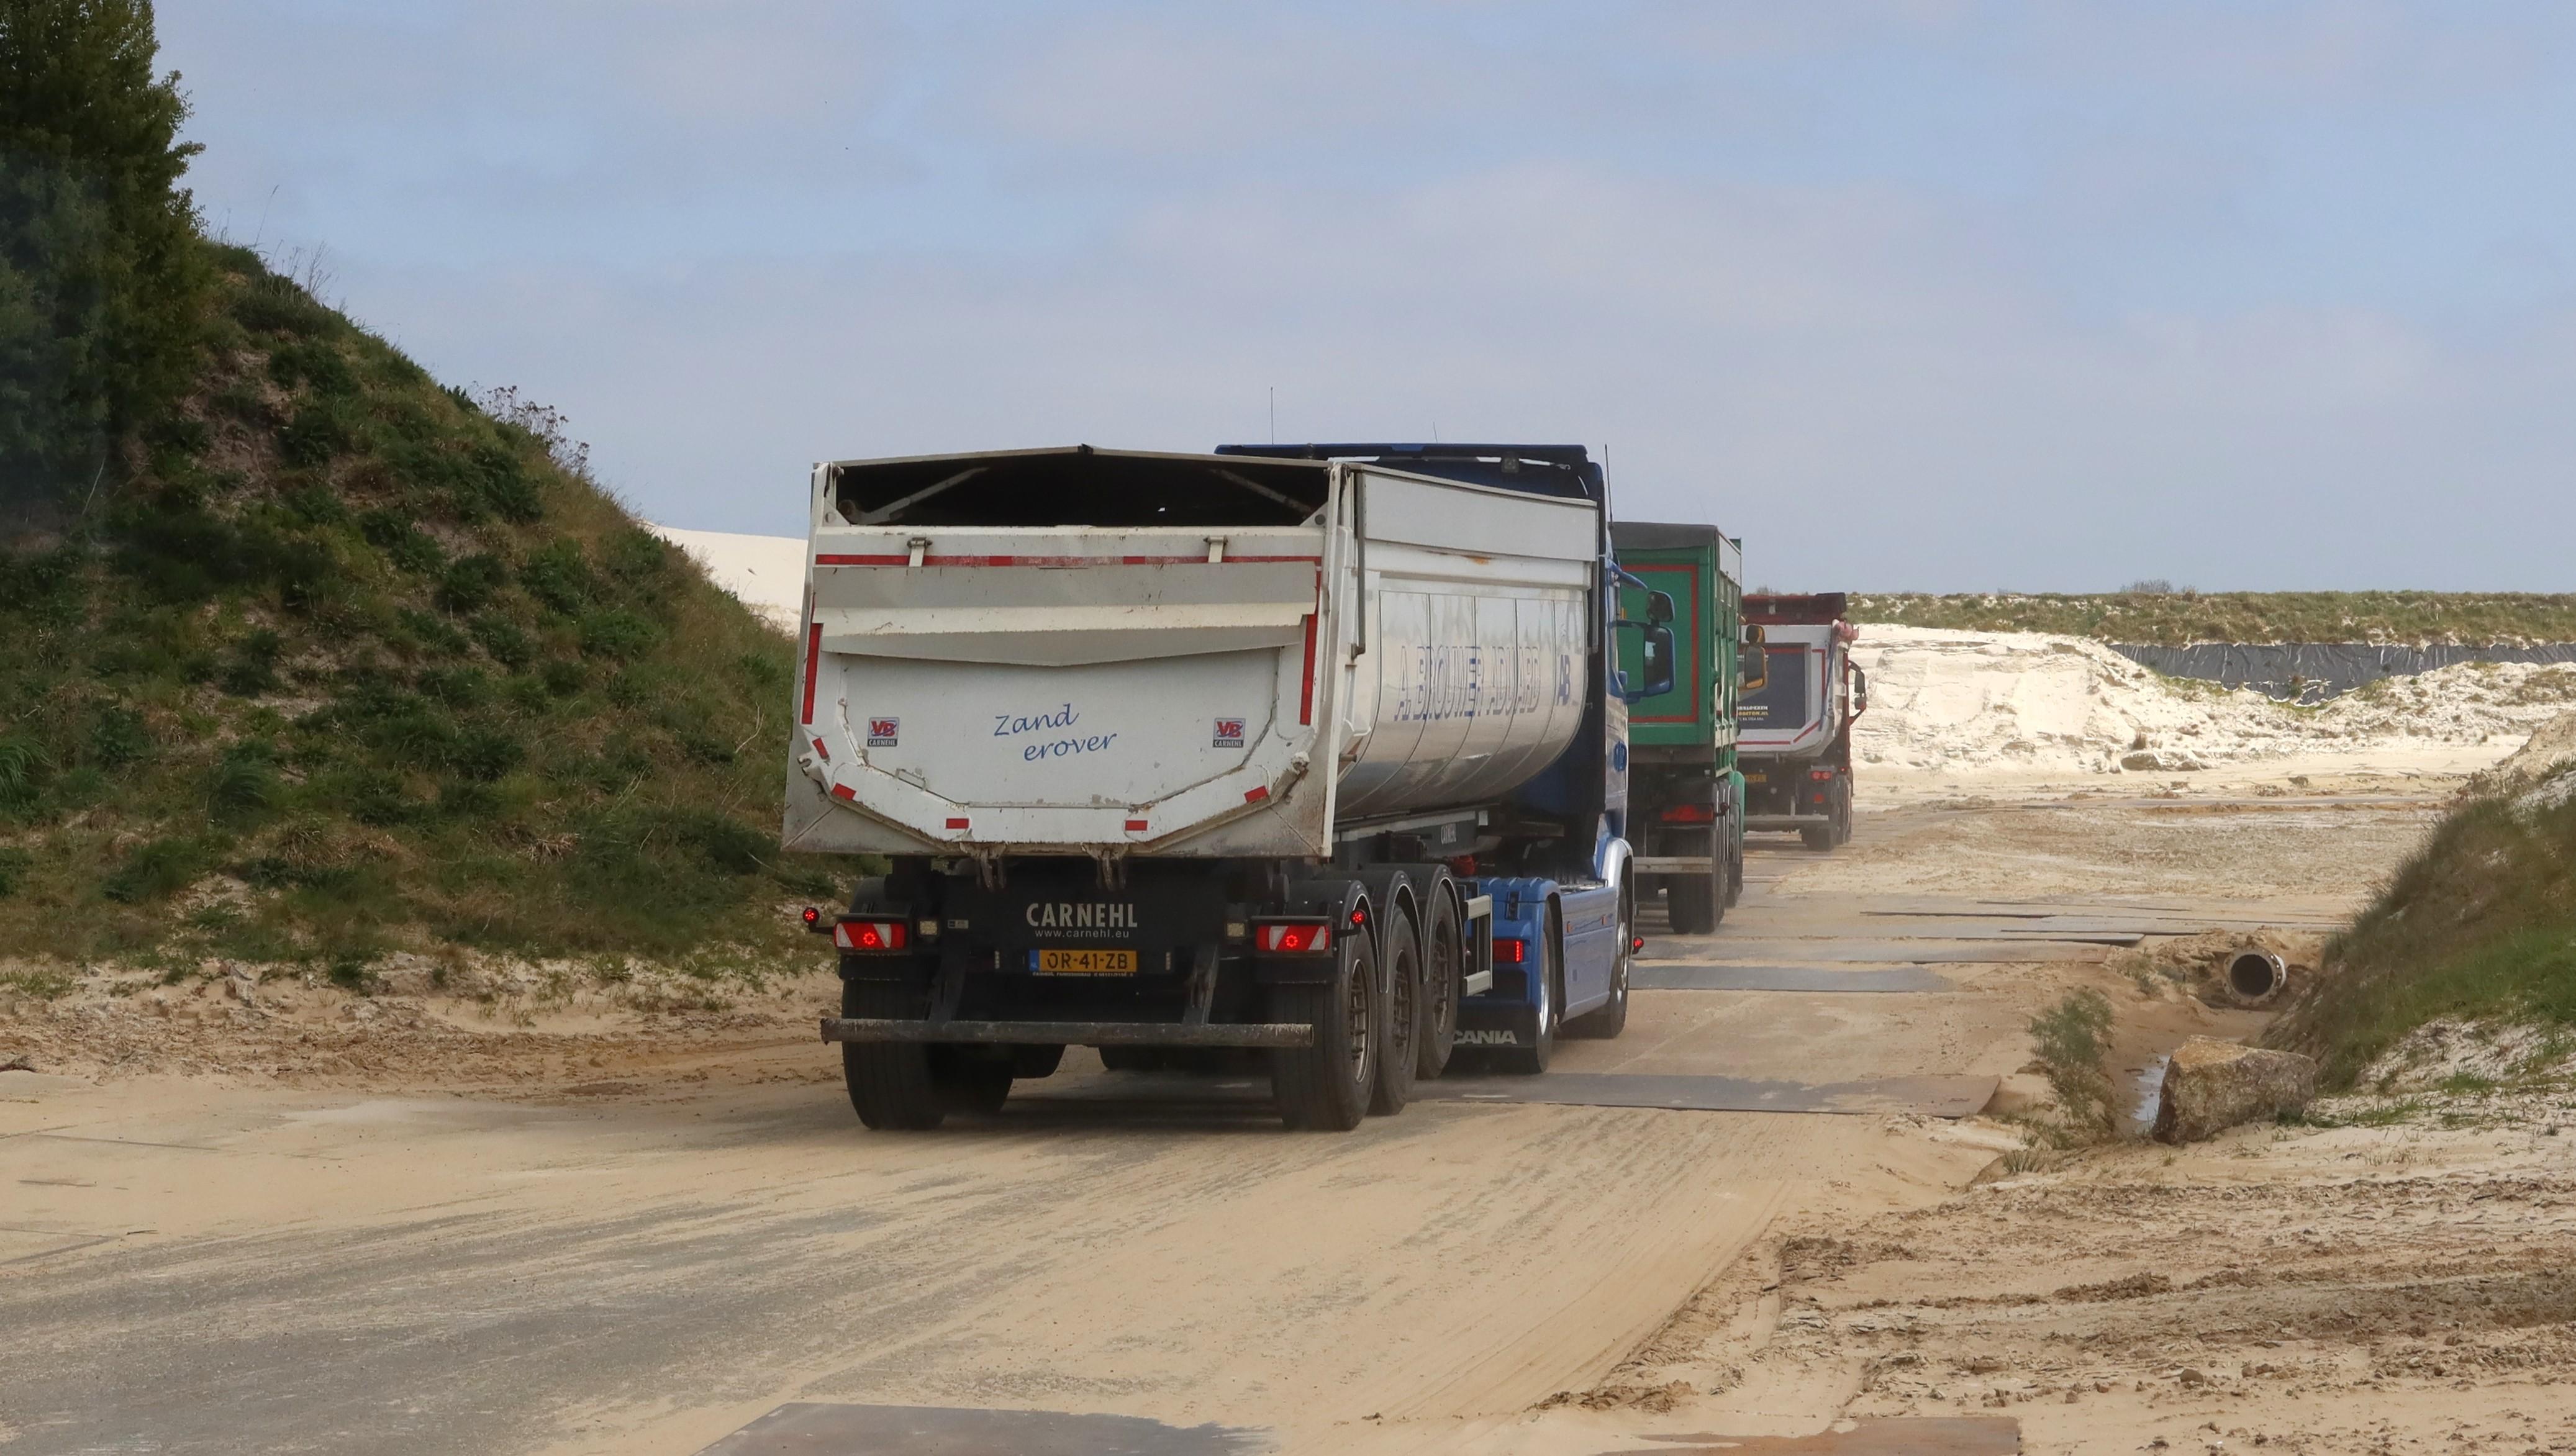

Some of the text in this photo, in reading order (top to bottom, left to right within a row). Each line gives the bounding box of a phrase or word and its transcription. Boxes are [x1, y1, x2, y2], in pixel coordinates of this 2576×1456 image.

[1413, 644, 1485, 721] BROUWER
[994, 702, 1080, 737] Zand
[1023, 733, 1118, 761] erover
[1026, 903, 1138, 928] CARNEHL
[1035, 929, 1130, 939] www.carnehl.eu
[1047, 952, 1128, 970] OR-41-ZB
[1453, 1029, 1518, 1044] CANIA
